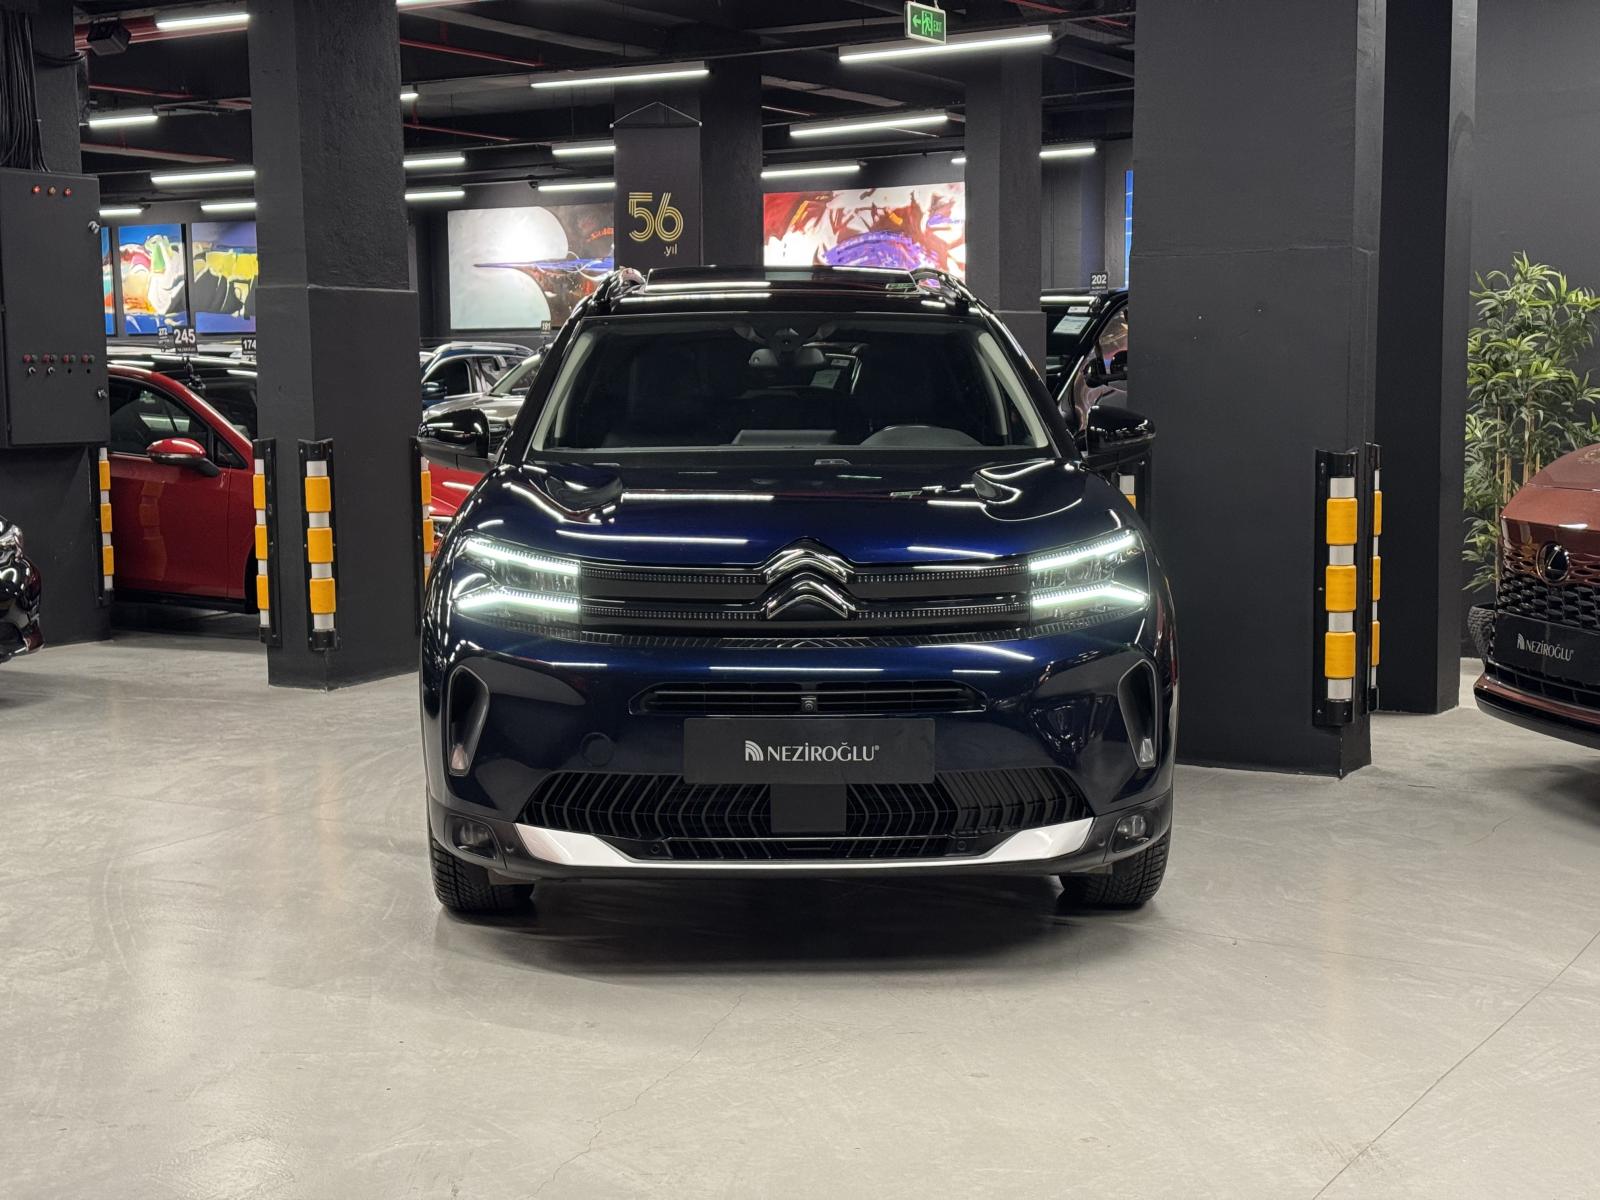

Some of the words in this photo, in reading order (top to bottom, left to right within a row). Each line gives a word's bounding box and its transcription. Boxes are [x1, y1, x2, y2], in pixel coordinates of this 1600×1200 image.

[933, 20, 942, 33] EXIT
[628, 191, 684, 242] 56
[1091, 274, 1107, 285] 202
[173, 328, 196, 345] 245
